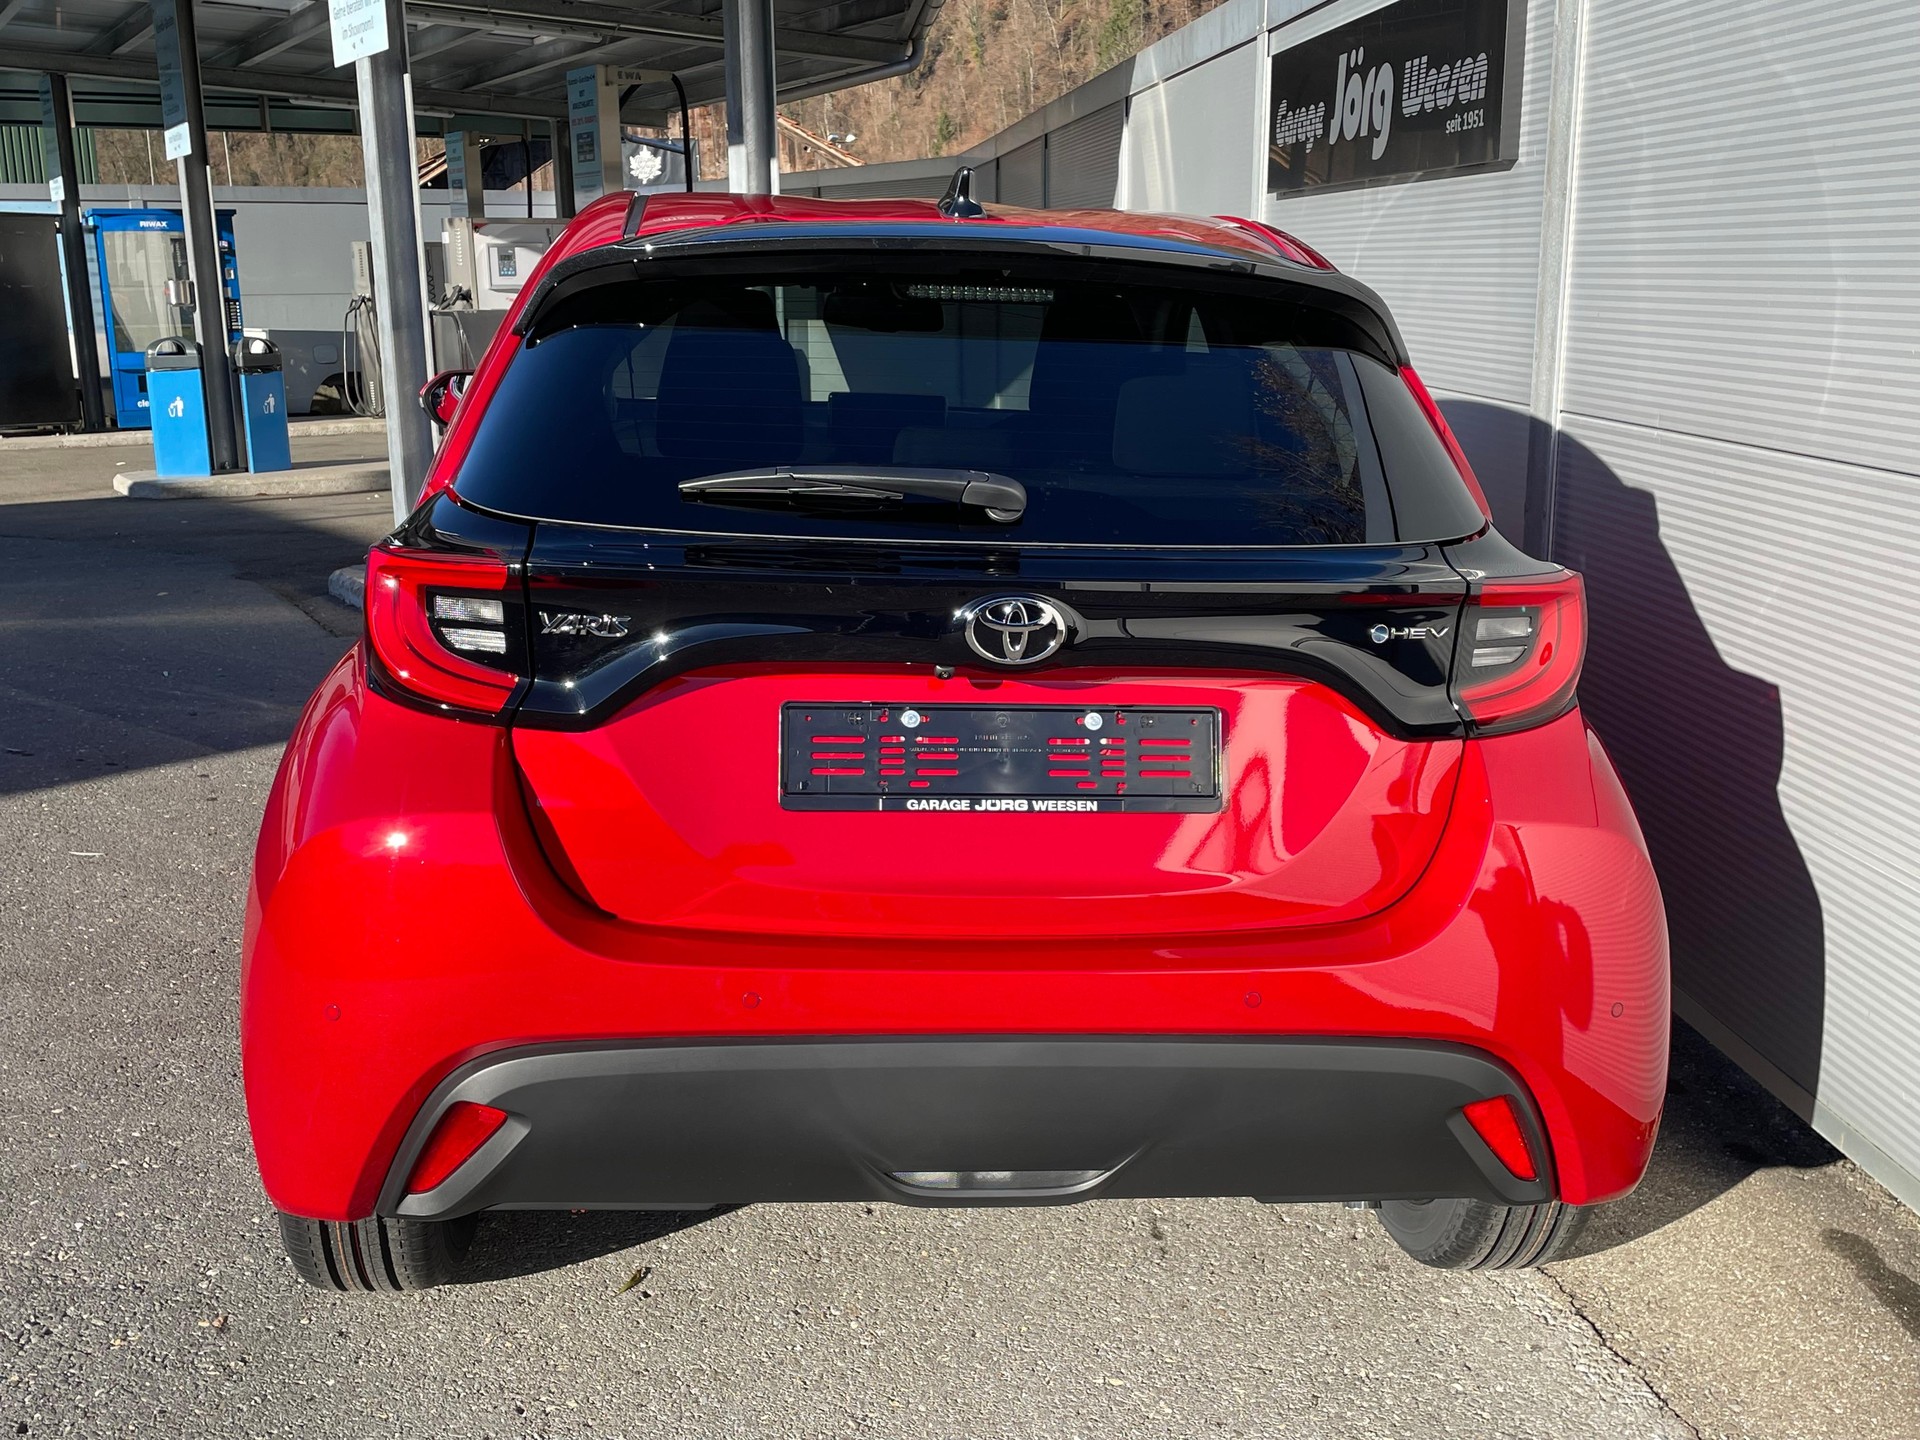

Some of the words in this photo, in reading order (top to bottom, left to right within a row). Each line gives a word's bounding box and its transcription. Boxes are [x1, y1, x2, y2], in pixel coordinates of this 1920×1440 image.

[1328, 46, 1394, 161] Jörg
[1445, 113, 1462, 134] seit
[1462, 108, 1485, 131] 1951
[139, 220, 168, 228] RIWAX
[137, 399, 150, 408] cle
[539, 611, 632, 638] YARIS
[1390, 626, 1450, 640] HEV
[906, 799, 971, 812] GARAGE
[974, 799, 1030, 812] JÖRG
[1032, 799, 1099, 812] WEESEN
